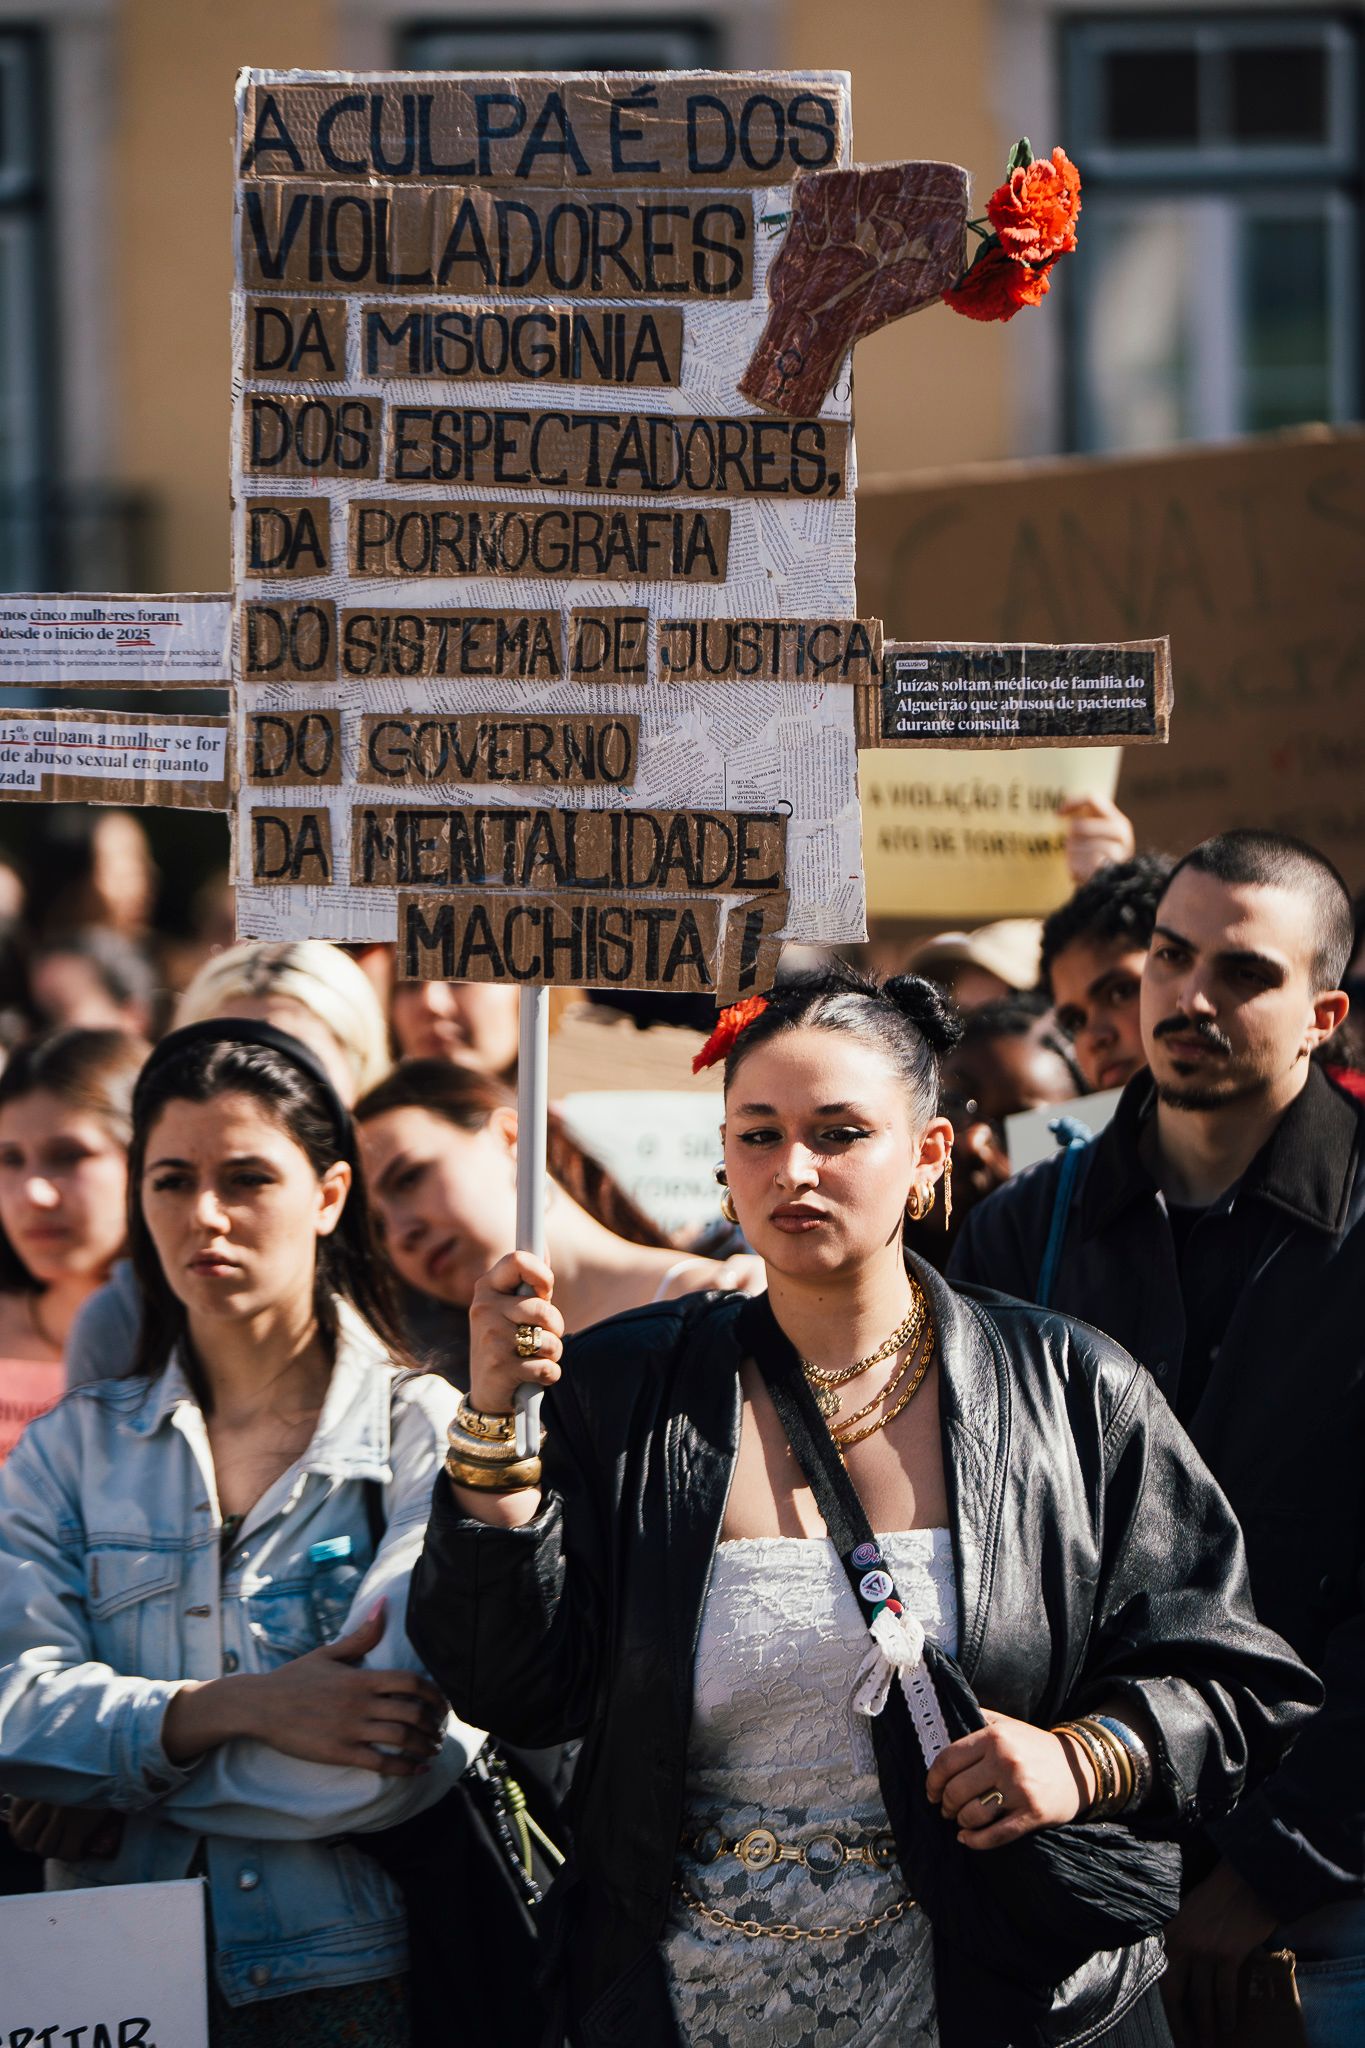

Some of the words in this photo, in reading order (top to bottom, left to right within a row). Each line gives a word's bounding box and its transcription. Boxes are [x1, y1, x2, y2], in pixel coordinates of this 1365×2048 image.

[241, 94, 304, 172] A
[317, 92, 592, 179] CULPA
[610, 84, 661, 173] É
[687, 92, 836, 173] DOS
[245, 192, 746, 294] VIOLADORES
[254, 307, 335, 372] DA
[366, 311, 671, 383] MISOGINIA
[250, 399, 373, 469] DOS
[394, 410, 842, 496] ESPECTADORES,
[246, 506, 327, 571] DA
[356, 508, 719, 577] PORNOGRAFIA
[30, 608, 67, 621] cinco
[70, 608, 135, 621] mulheres
[138, 609, 180, 622] foram
[43, 629, 52, 640] o
[55, 627, 94, 640] início
[97, 628, 115, 640] de
[117, 628, 150, 640] 2025
[247, 605, 330, 673] DO
[343, 615, 559, 677] SISTEMA
[571, 616, 647, 672] DE
[660, 622, 881, 678] JUSTIÇA
[895, 678, 939, 694] Juízas
[942, 678, 991, 691] soltam
[994, 677, 1048, 691] médico
[1050, 676, 1069, 690] de
[1071, 675, 1123, 690] família
[1124, 675, 1145, 688] do
[896, 697, 968, 715] Algueirão
[970, 699, 998, 713] que
[1000, 696, 1054, 710] abusou
[1056, 696, 1075, 709] de
[1077, 695, 1147, 712] pacientes
[1, 725, 29, 742] 15%
[33, 727, 93, 745] culpam
[99, 732, 107, 745] a
[111, 731, 170, 749] mulher
[175, 738, 191, 750] se
[196, 735, 221, 752] for
[250, 713, 333, 779] DO
[367, 720, 633, 781] GOVERNO
[896, 718, 955, 731] durante
[957, 717, 1020, 730] consulta
[1, 747, 21, 762] de
[24, 748, 72, 766] abuso
[76, 753, 128, 769] sexual
[132, 756, 209, 774] enquanto
[253, 814, 329, 878] DA
[364, 810, 779, 890] MENTALIDADE
[405, 904, 713, 985] MACHISTA
